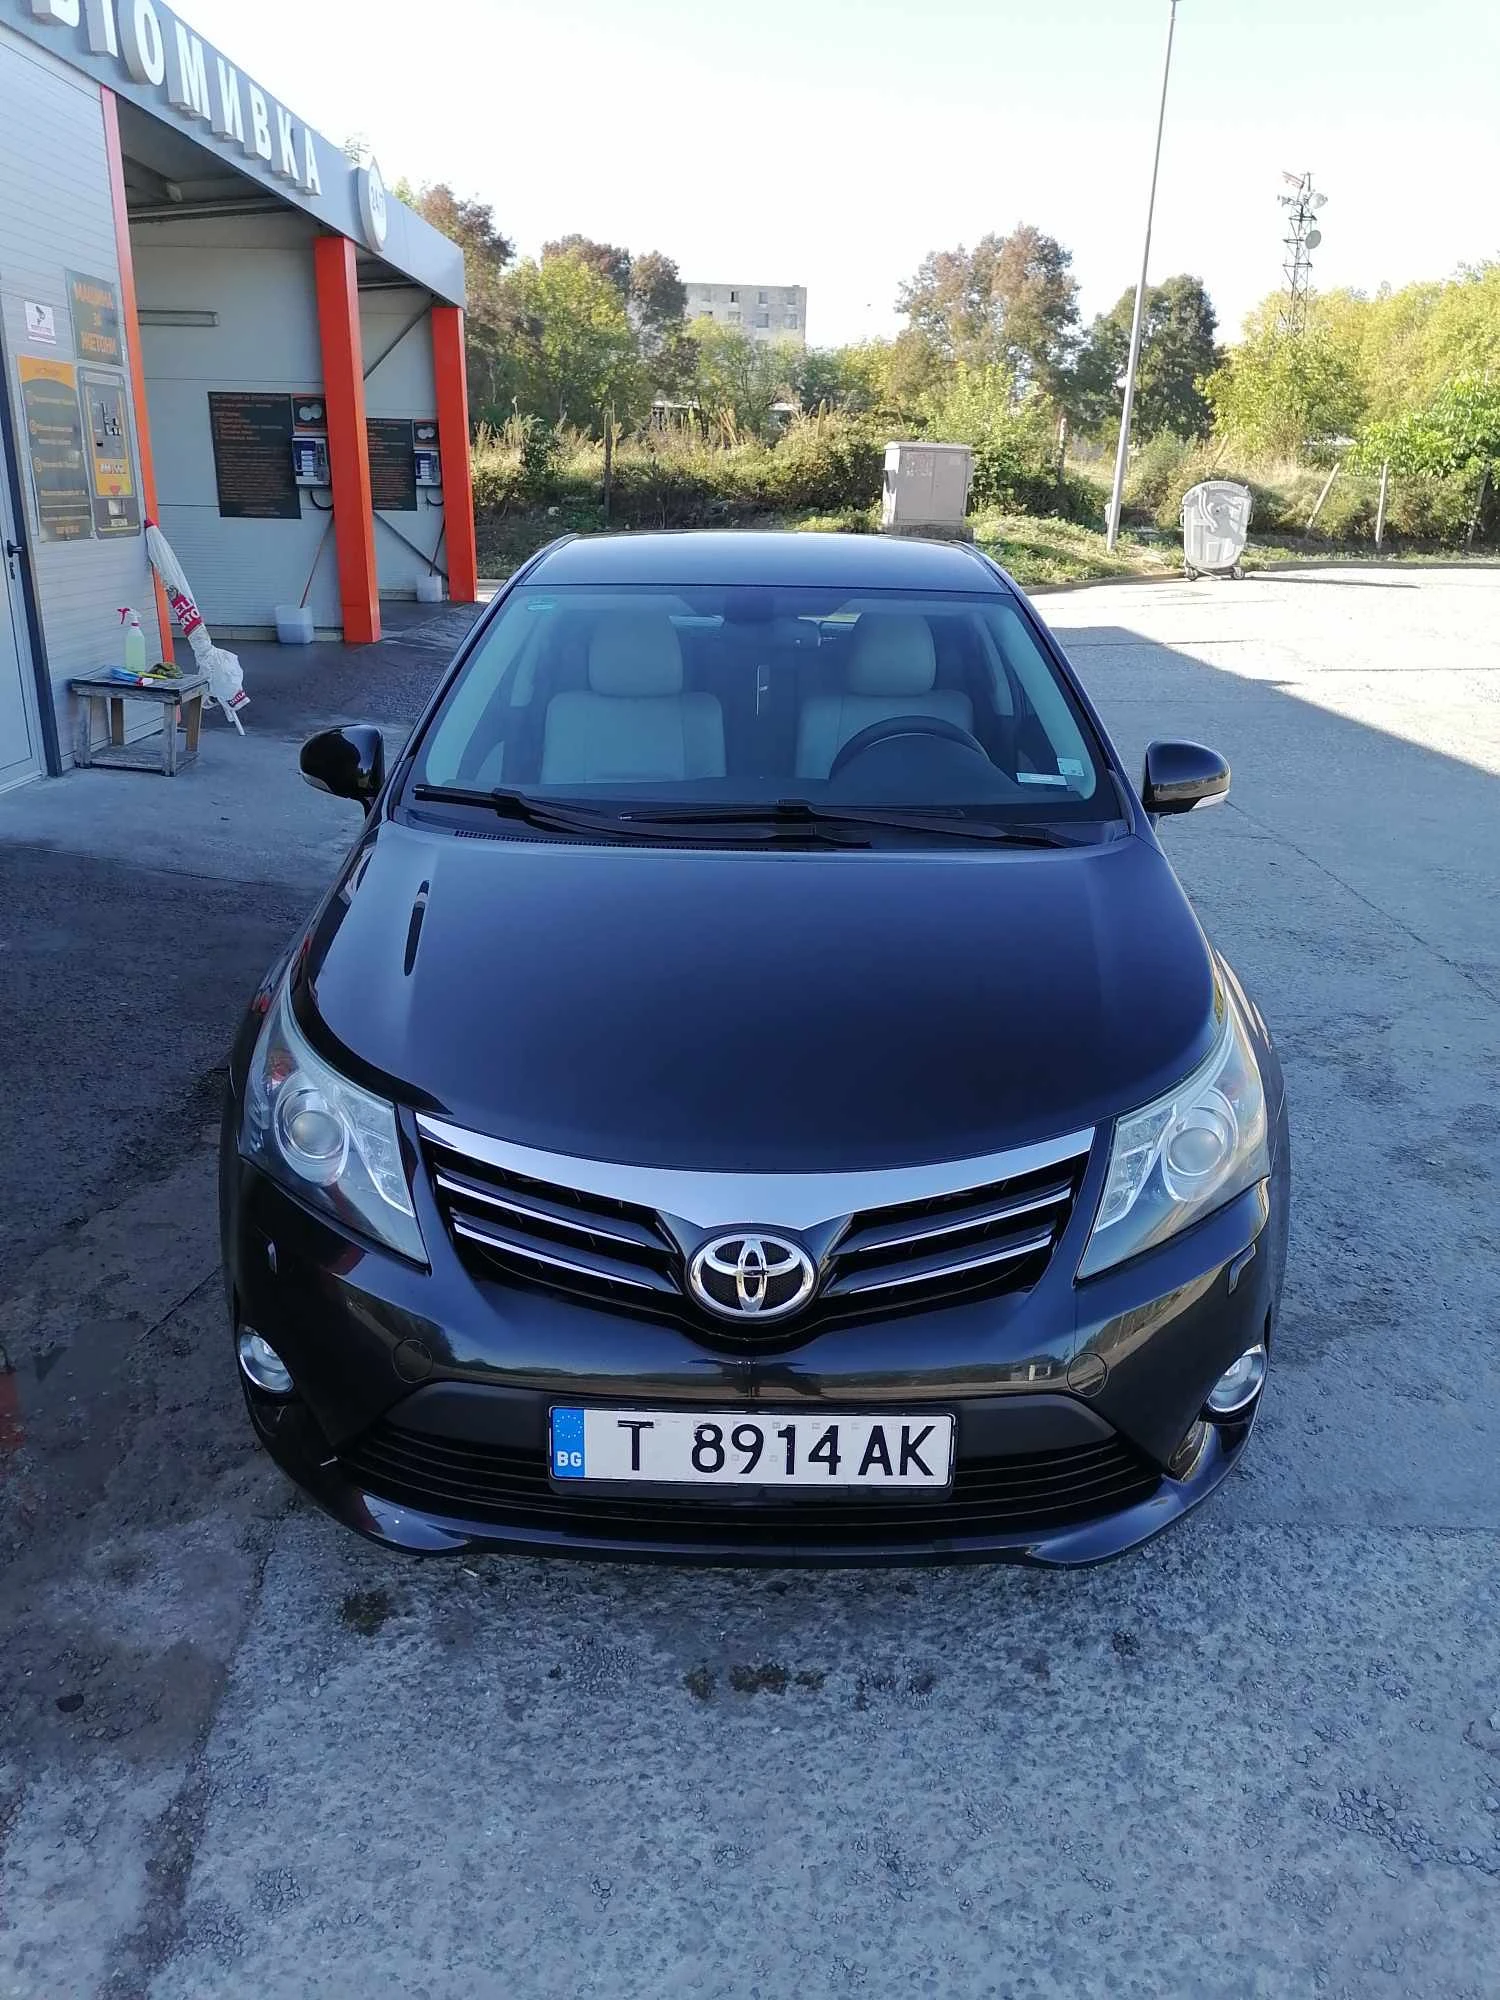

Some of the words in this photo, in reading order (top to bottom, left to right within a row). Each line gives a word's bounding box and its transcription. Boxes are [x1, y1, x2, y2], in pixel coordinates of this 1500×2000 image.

[32, 0, 322, 196] ОМИВКА
[557, 1451, 582, 1467] BG
[617, 1420, 654, 1471] T
[691, 1424, 842, 1475] 8914
[858, 1425, 936, 1476] AK
